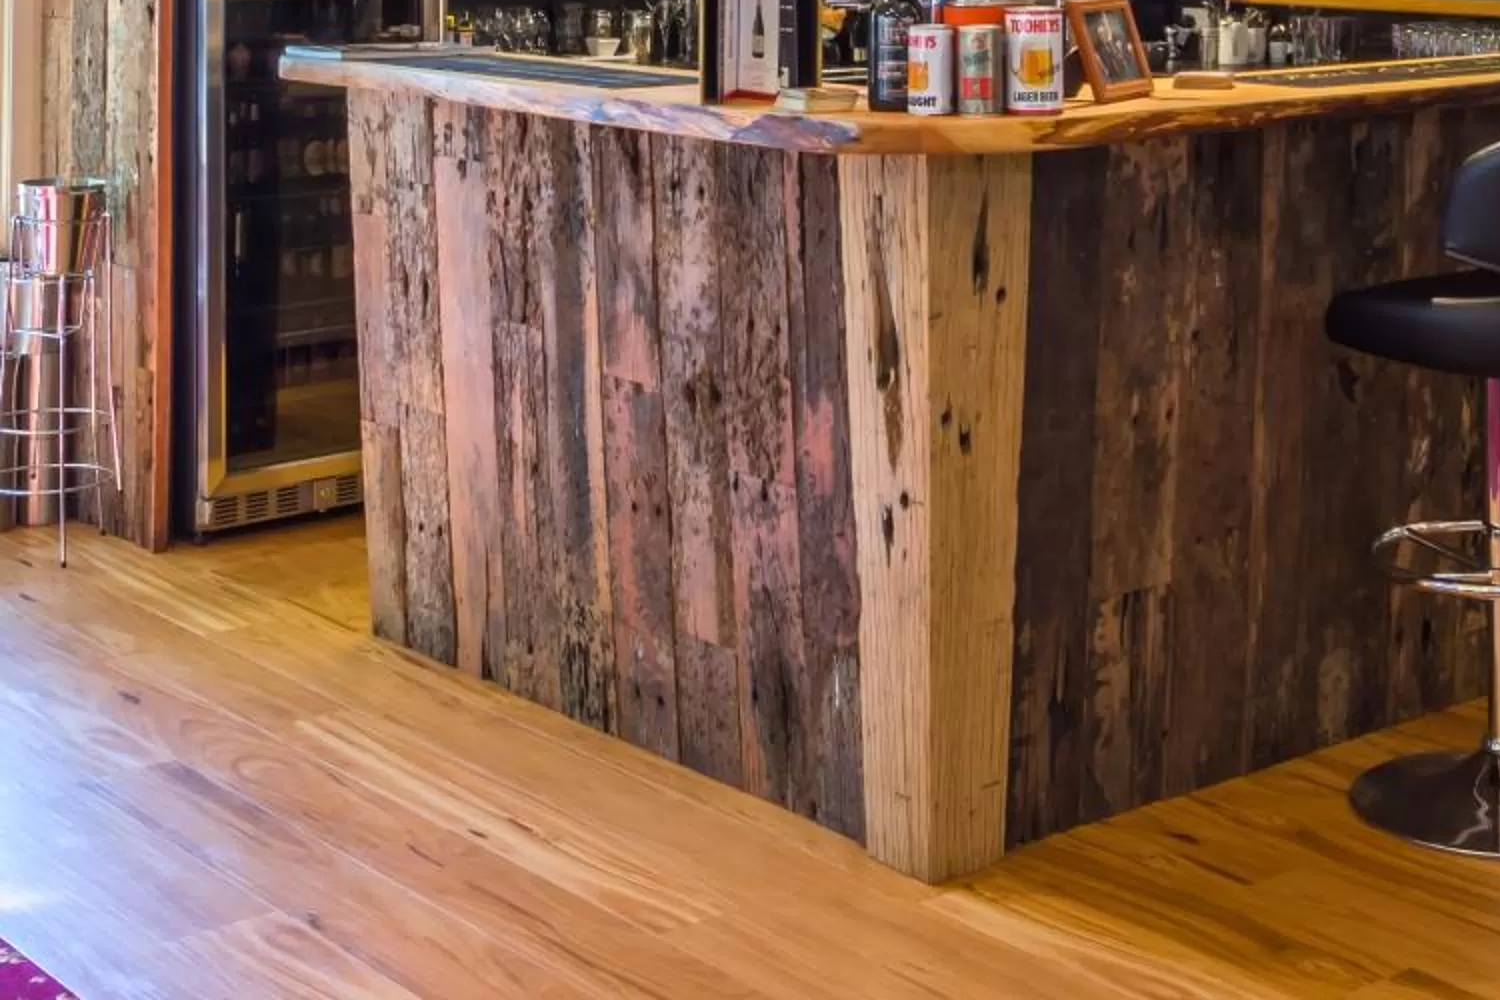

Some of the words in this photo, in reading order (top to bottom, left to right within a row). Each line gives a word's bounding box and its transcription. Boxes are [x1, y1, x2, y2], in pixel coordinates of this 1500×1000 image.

[1010, 18, 1060, 33] TOOHEYS
[1013, 91, 1039, 102] LAGER
[1040, 91, 1059, 102] BEER
